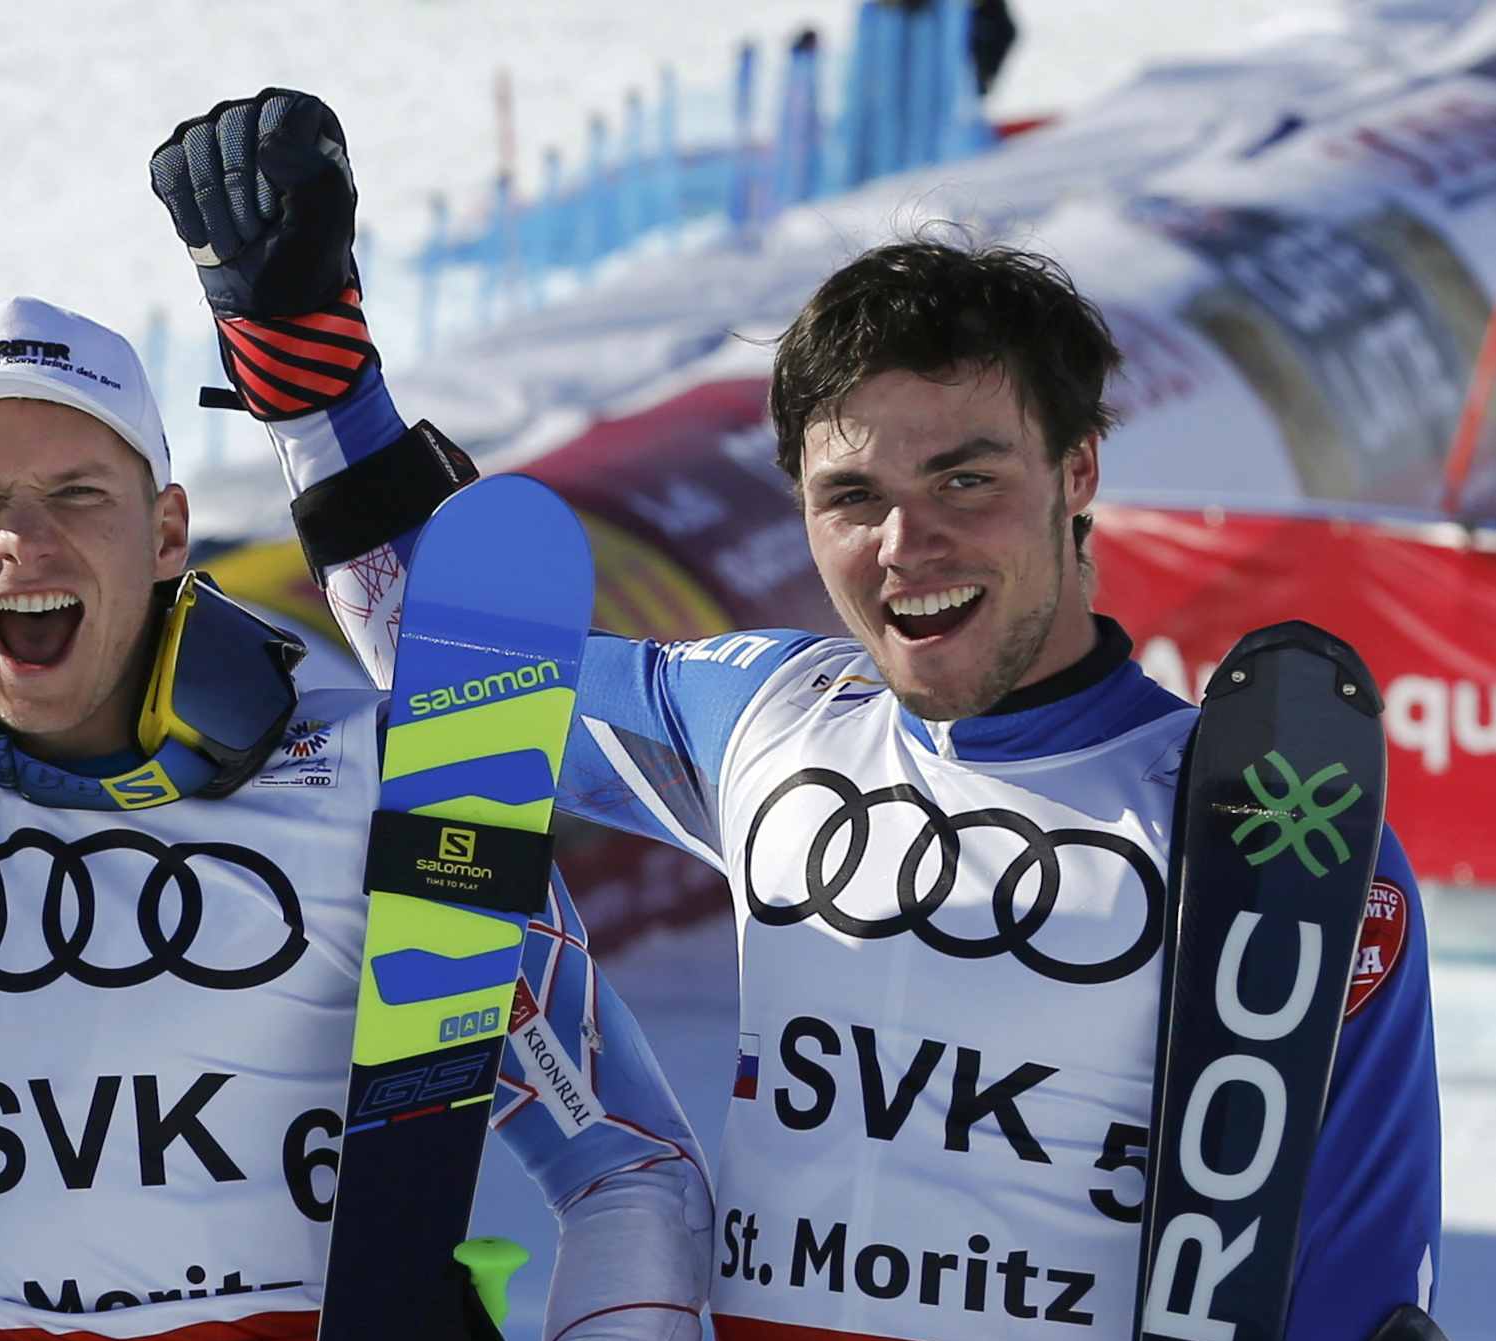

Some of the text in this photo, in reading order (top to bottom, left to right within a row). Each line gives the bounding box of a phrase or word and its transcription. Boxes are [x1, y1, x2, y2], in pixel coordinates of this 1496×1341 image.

[426, 876, 480, 891] TIME TO PLAY
[440, 1008, 501, 1041] LAB
[522, 1024, 591, 1128] KRONREAL
[774, 1015, 1061, 1165] SVK
[282, 1108, 341, 1225] 6
[1087, 1121, 1149, 1224] 5
[720, 1207, 1096, 1326] St. Moritz
